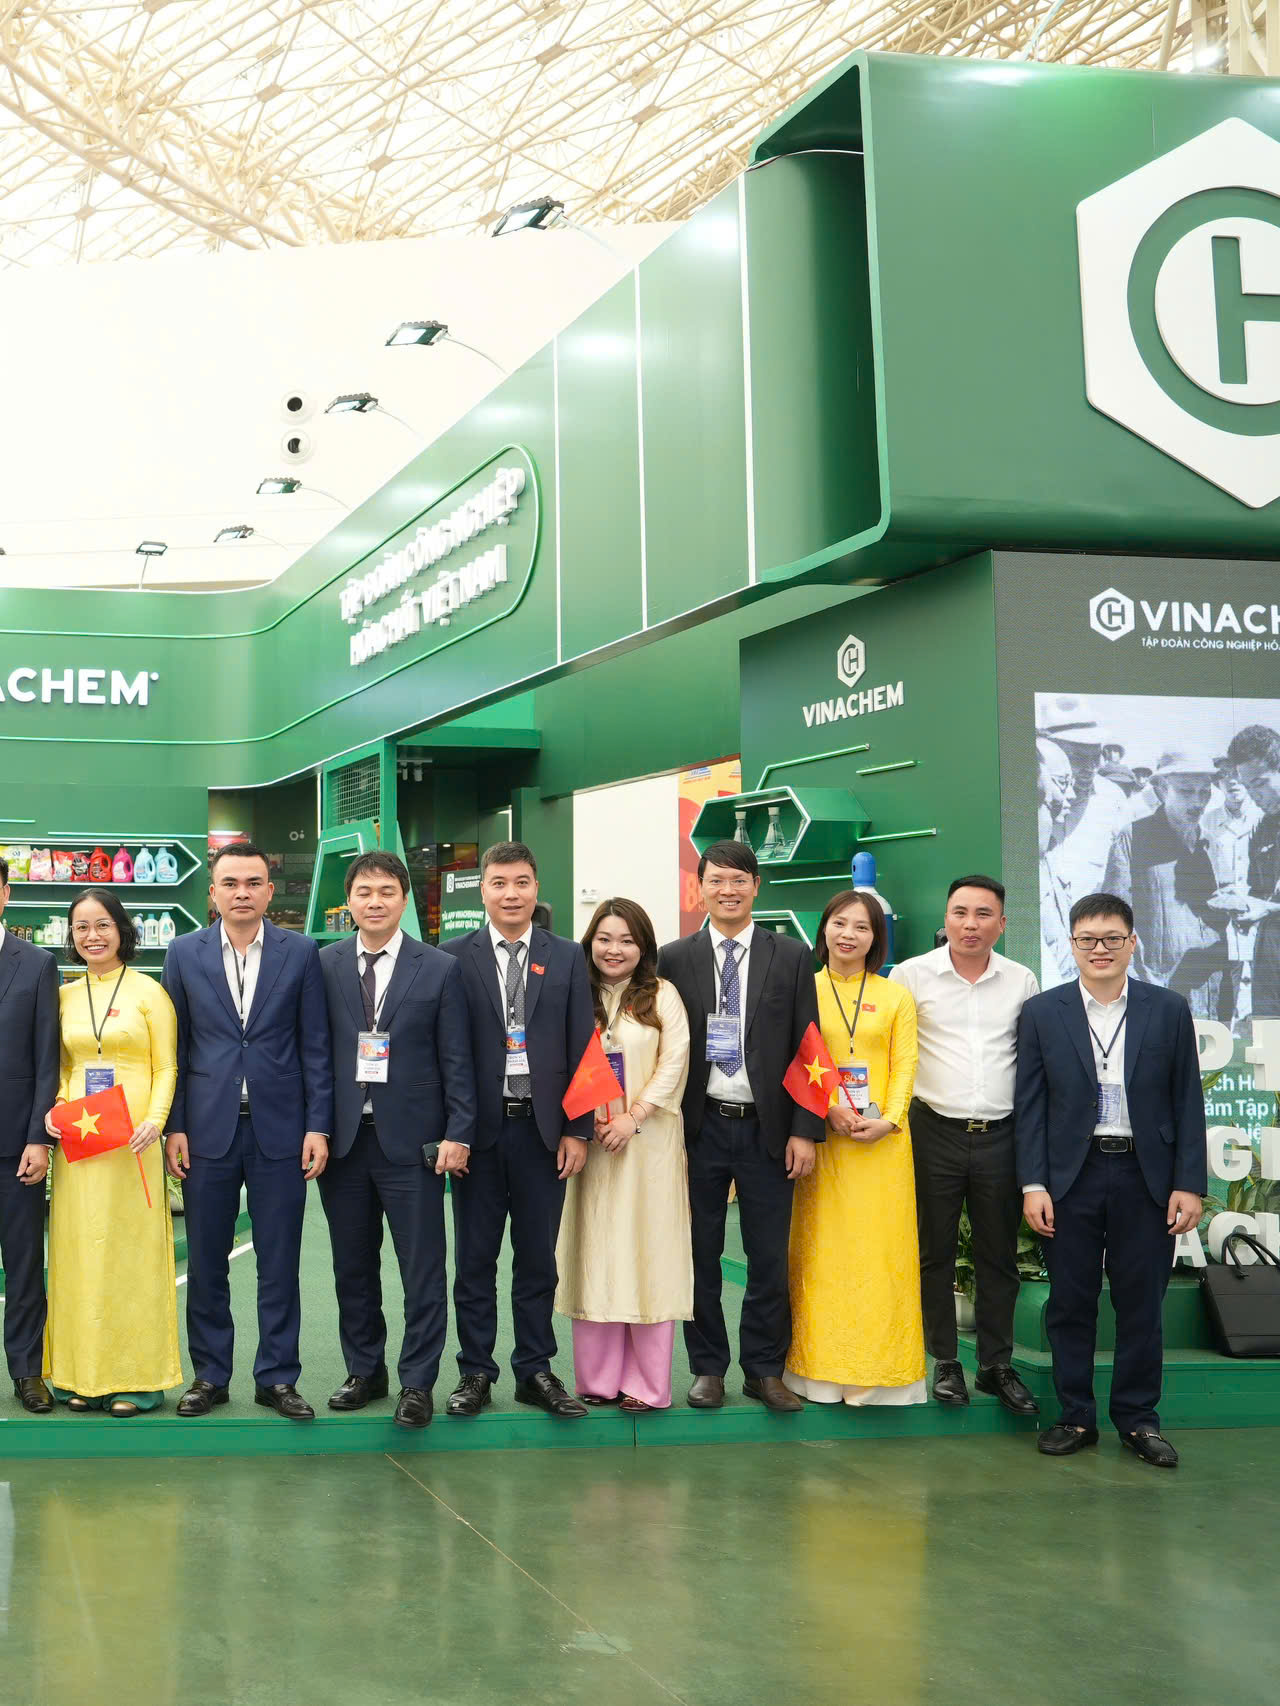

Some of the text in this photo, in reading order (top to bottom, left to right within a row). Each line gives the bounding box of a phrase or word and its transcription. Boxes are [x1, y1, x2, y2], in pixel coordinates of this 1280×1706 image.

[1141, 636, 1159, 650] TẬP
[1161, 636, 1191, 649] ĐOÀN
[1192, 637, 1224, 649] CÔNG
[1226, 639, 1262, 652] NGHIỆP
[802, 681, 904, 728] VINACHEM
